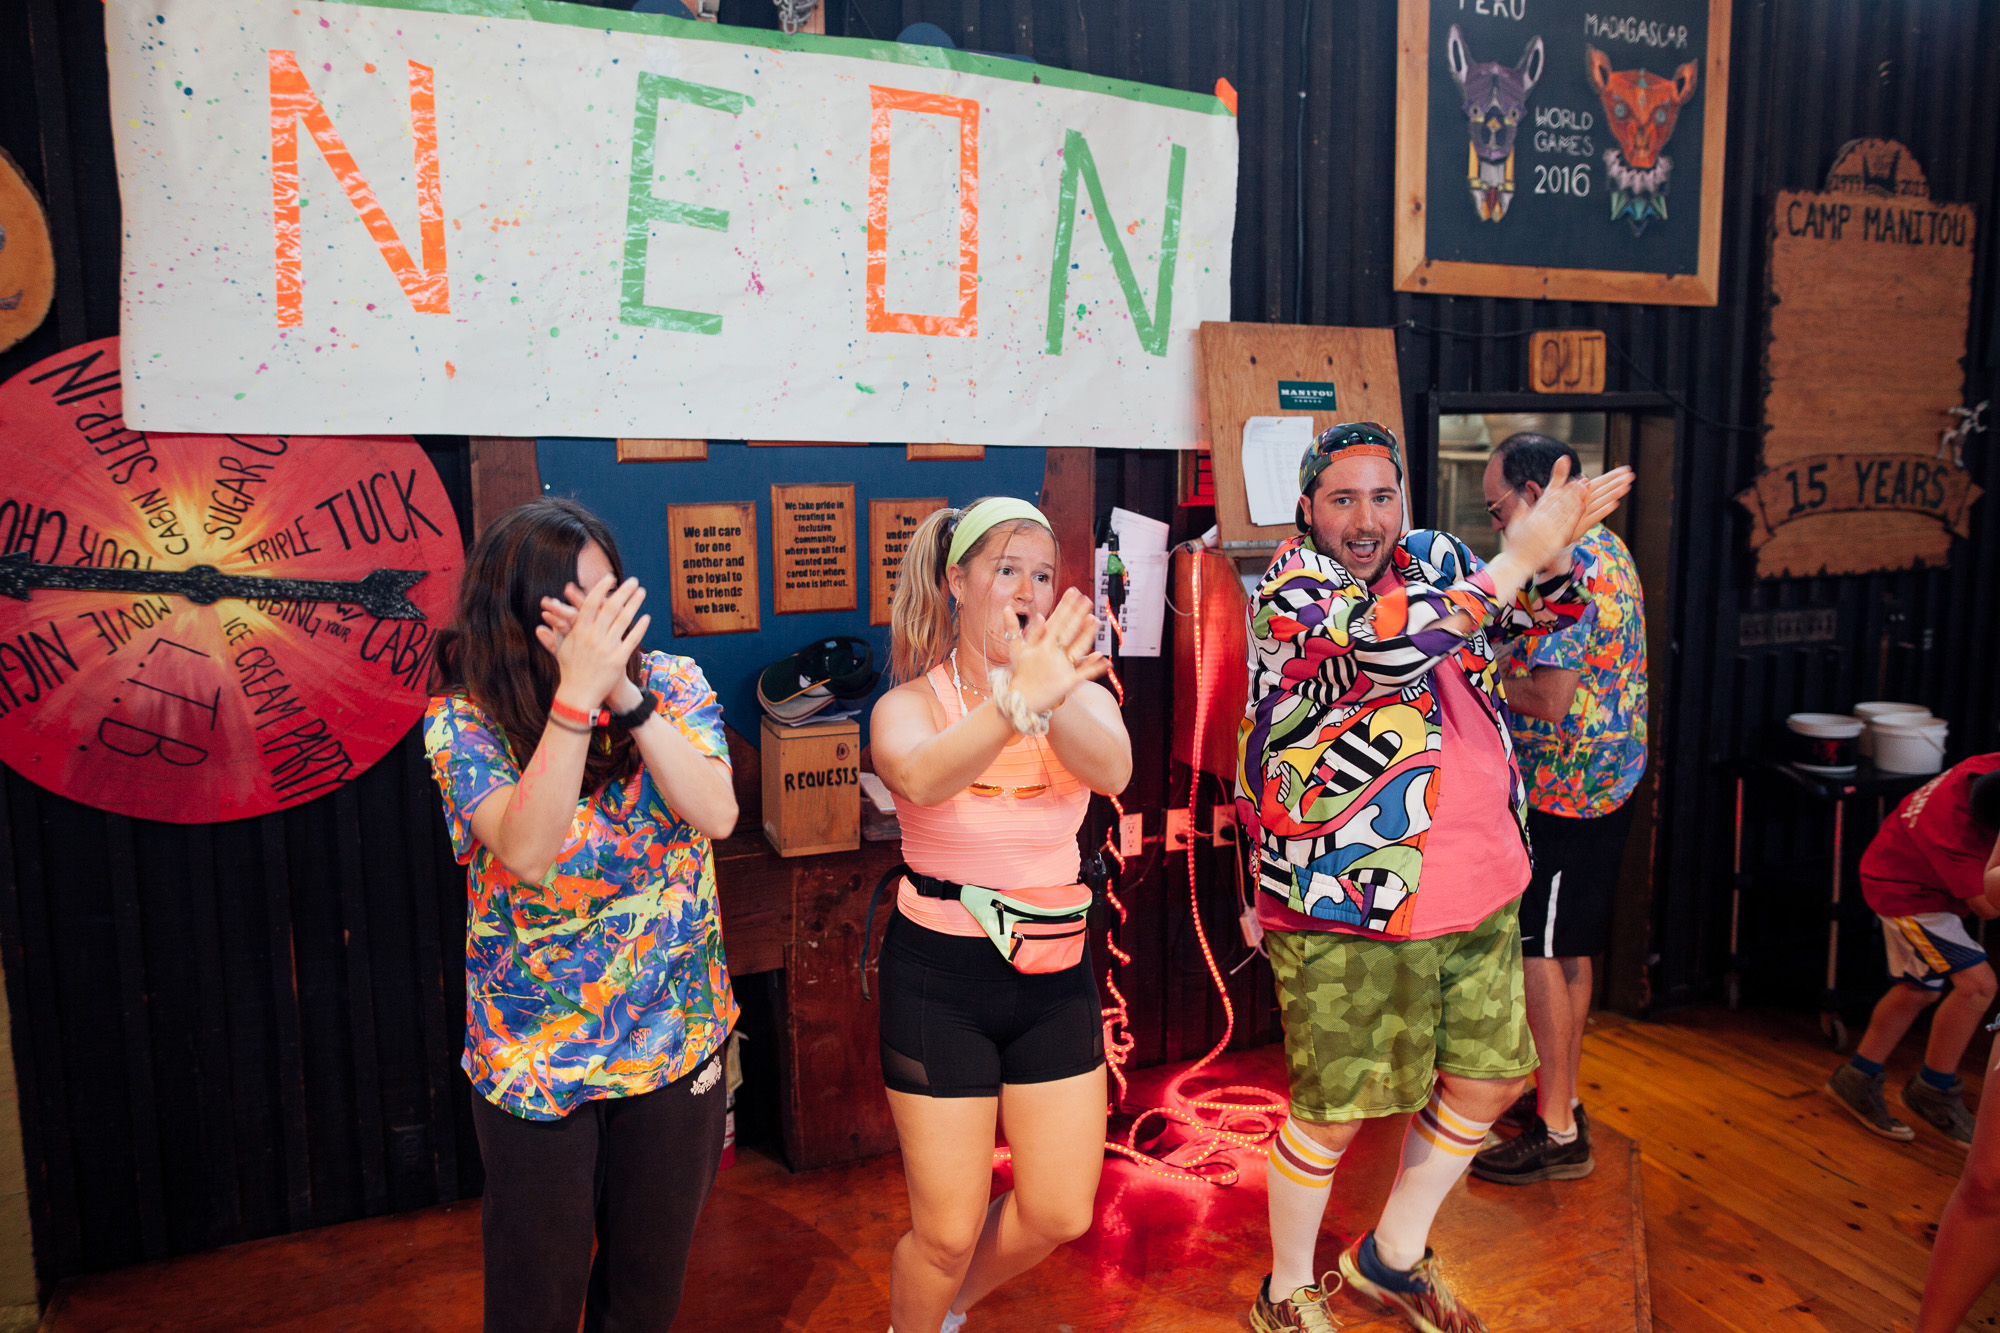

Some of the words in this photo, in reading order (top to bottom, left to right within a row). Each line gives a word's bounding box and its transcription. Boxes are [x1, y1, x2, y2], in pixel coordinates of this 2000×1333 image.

[1584, 13, 1688, 49] MADAGASCAR
[1535, 106, 1594, 131] WORLD
[1534, 130, 1594, 157] GAMES
[1534, 163, 1592, 197] 2016
[269, 50, 1187, 357] NEON
[1787, 201, 1850, 240] CAMP
[1863, 206, 1967, 247] MANITOU
[1541, 336, 1602, 387] OUT
[1281, 389, 1333, 397] MANITOU
[1785, 463, 1828, 515] 15
[1855, 460, 1949, 509] YEARS
[203, 456, 275, 540] SUGAR
[785, 502, 797, 510] We
[798, 502, 814, 510] take
[816, 501, 835, 510] pride
[837, 501, 844, 509] in
[131, 488, 189, 555] CABIN
[241, 515, 321, 564] TRIPLE
[315, 469, 443, 550] TUCK
[794, 513, 825, 521] creating
[903, 517, 917, 526] We
[683, 527, 700, 538] We
[703, 526, 716, 537] all
[718, 527, 741, 537] care
[798, 524, 832, 532] inclusive
[695, 542, 710, 553] for
[712, 542, 731, 552] one
[794, 535, 836, 544] community
[885, 543, 902, 552] that
[785, 547, 808, 555] where
[821, 546, 831, 554] all
[832, 545, 846, 553] feel
[683, 557, 723, 569] another
[725, 556, 745, 567] and
[795, 557, 822, 566] wanted
[823, 557, 837, 565] and
[686, 574, 704, 584] are
[706, 571, 730, 584] loyal
[732, 571, 742, 582] to
[786, 569, 808, 578] cared
[822, 568, 846, 576] where
[687, 588, 704, 599] the
[706, 586, 743, 598] friends
[785, 581, 795, 589] no
[812, 580, 818, 588] is
[820, 580, 832, 588] left
[694, 603, 710, 614] we
[711, 602, 740, 613] have.
[77, 596, 172, 656] MOVIE
[223, 616, 254, 647] ICE
[324, 620, 352, 643] YOUR
[235, 646, 307, 731] CREAM
[262, 718, 354, 803] PARTY
[784, 767, 858, 792] REQUESTS
